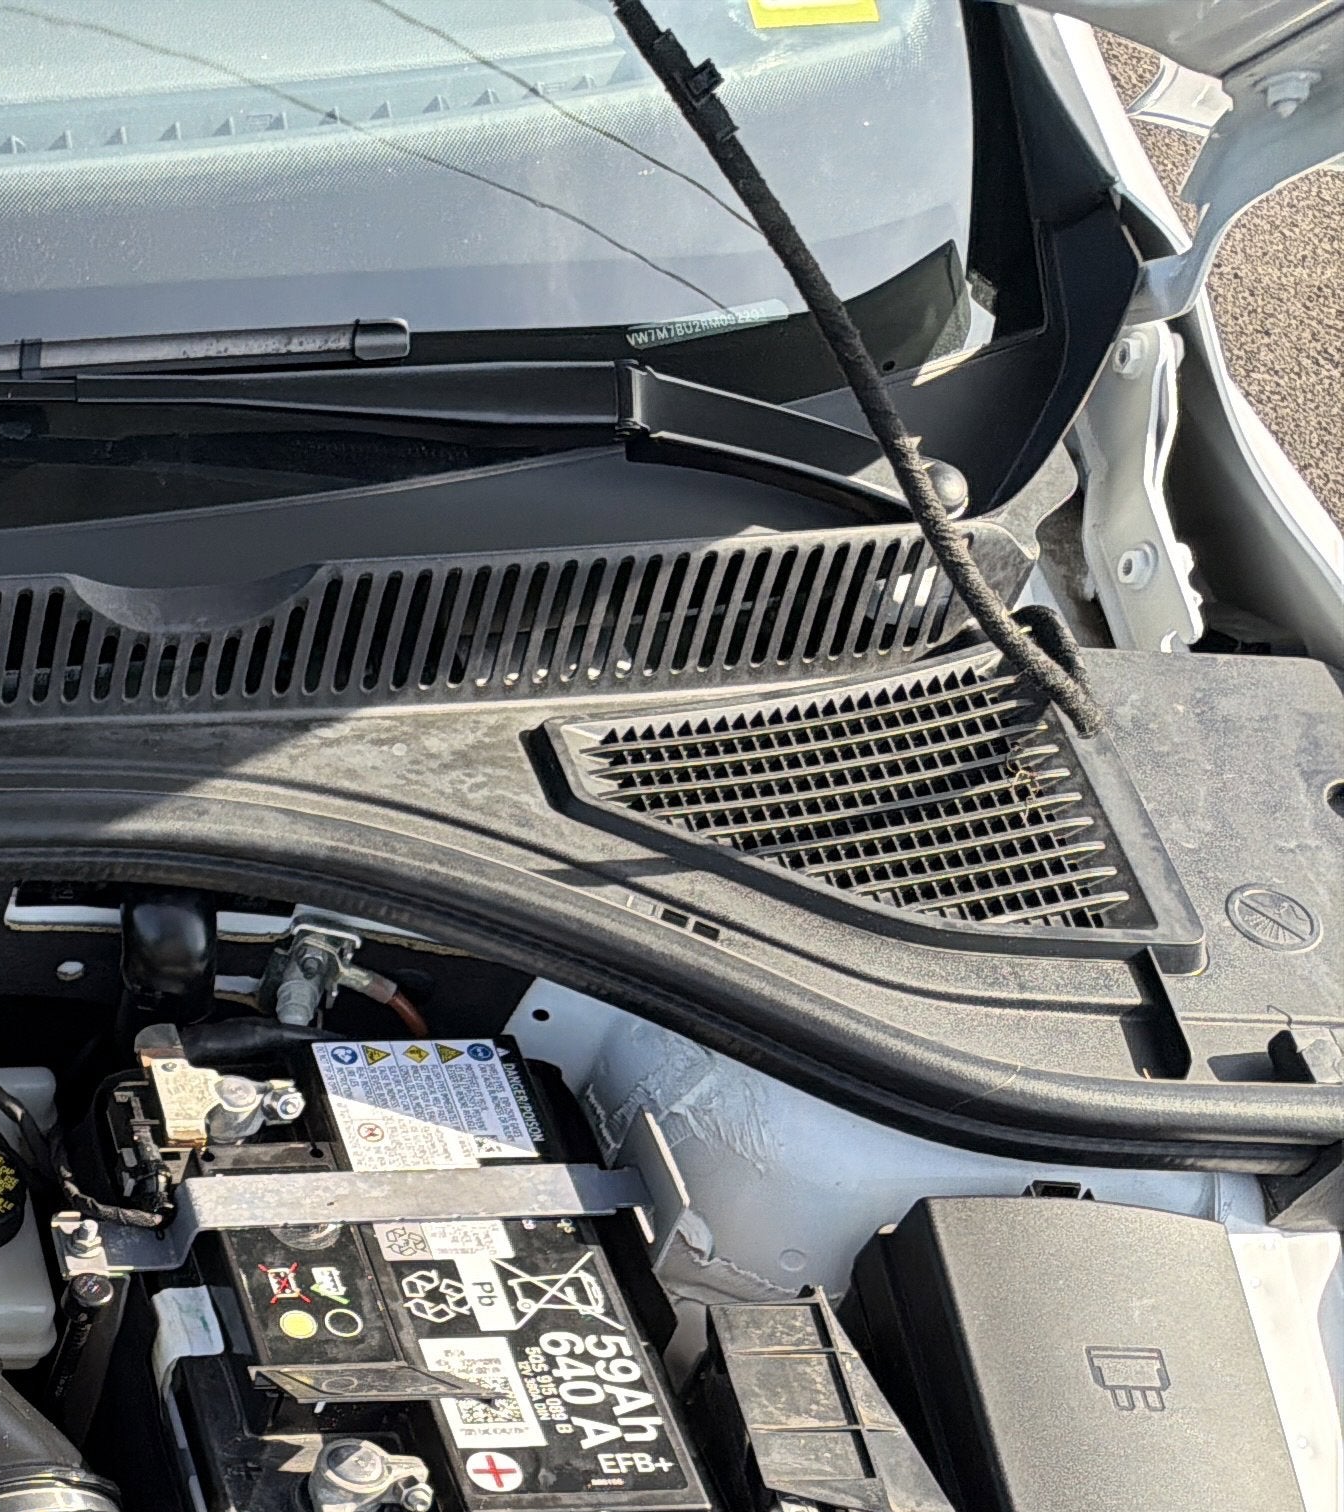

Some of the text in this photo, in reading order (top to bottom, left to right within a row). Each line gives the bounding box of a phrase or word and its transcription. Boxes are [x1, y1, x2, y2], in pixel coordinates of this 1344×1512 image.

[502, 1063, 545, 1142] DANGER/POISON
[472, 1281, 495, 1307] Pb
[539, 1332, 605, 1405] 640
[585, 1334, 664, 1442] 59Ah
[534, 1403, 550, 1420] DIN
[537, 1375, 557, 1396] 915
[556, 1424, 574, 1434] B
[571, 1416, 623, 1449] A
[597, 1453, 675, 1473] EFB+
